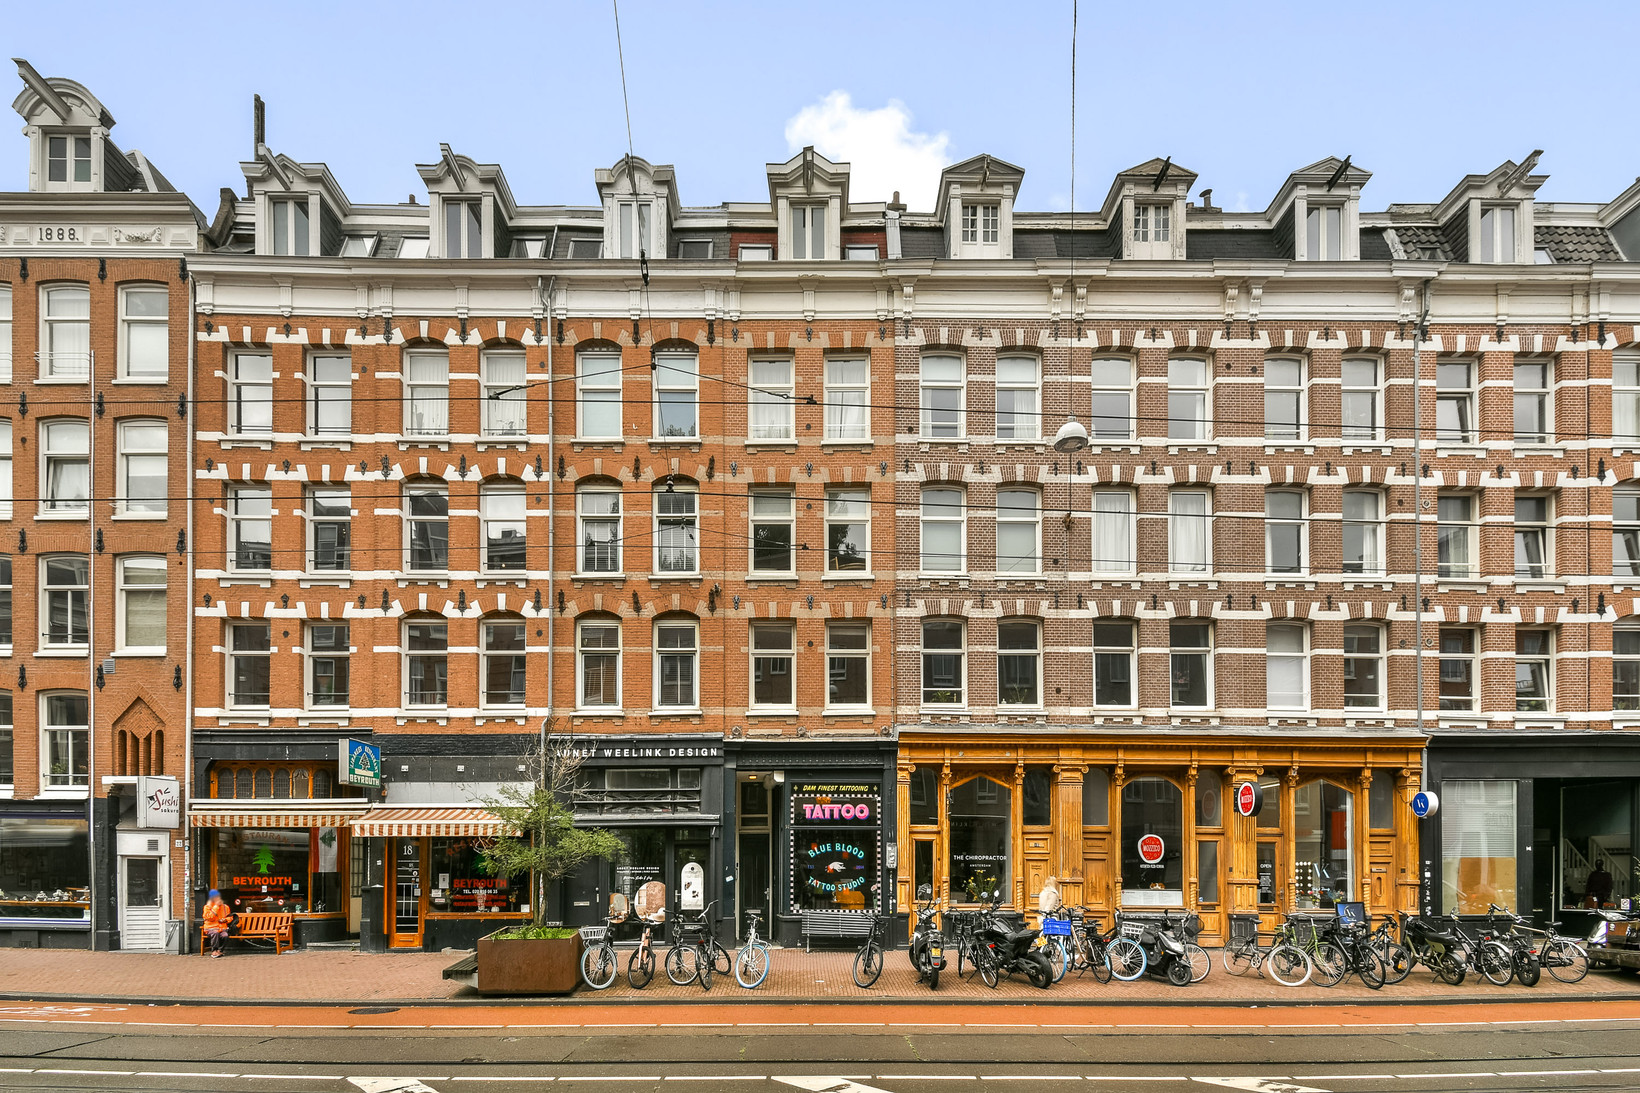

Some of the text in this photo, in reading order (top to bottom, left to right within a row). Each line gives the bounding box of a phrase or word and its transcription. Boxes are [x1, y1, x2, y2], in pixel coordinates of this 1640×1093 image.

[604, 748, 662, 757] WEELINK
[669, 748, 718, 757] DESIGN
[349, 774, 380, 786] BEYROUTH
[153, 788, 179, 811] Sushi
[803, 803, 870, 820] TATTOO
[403, 845, 413, 856] 18
[807, 843, 865, 859] BLUE BLOOD
[233, 876, 292, 885] BEYROUTH
[453, 879, 507, 889] BEYROUTH
[808, 875, 866, 891] TATTOO STUDIO
